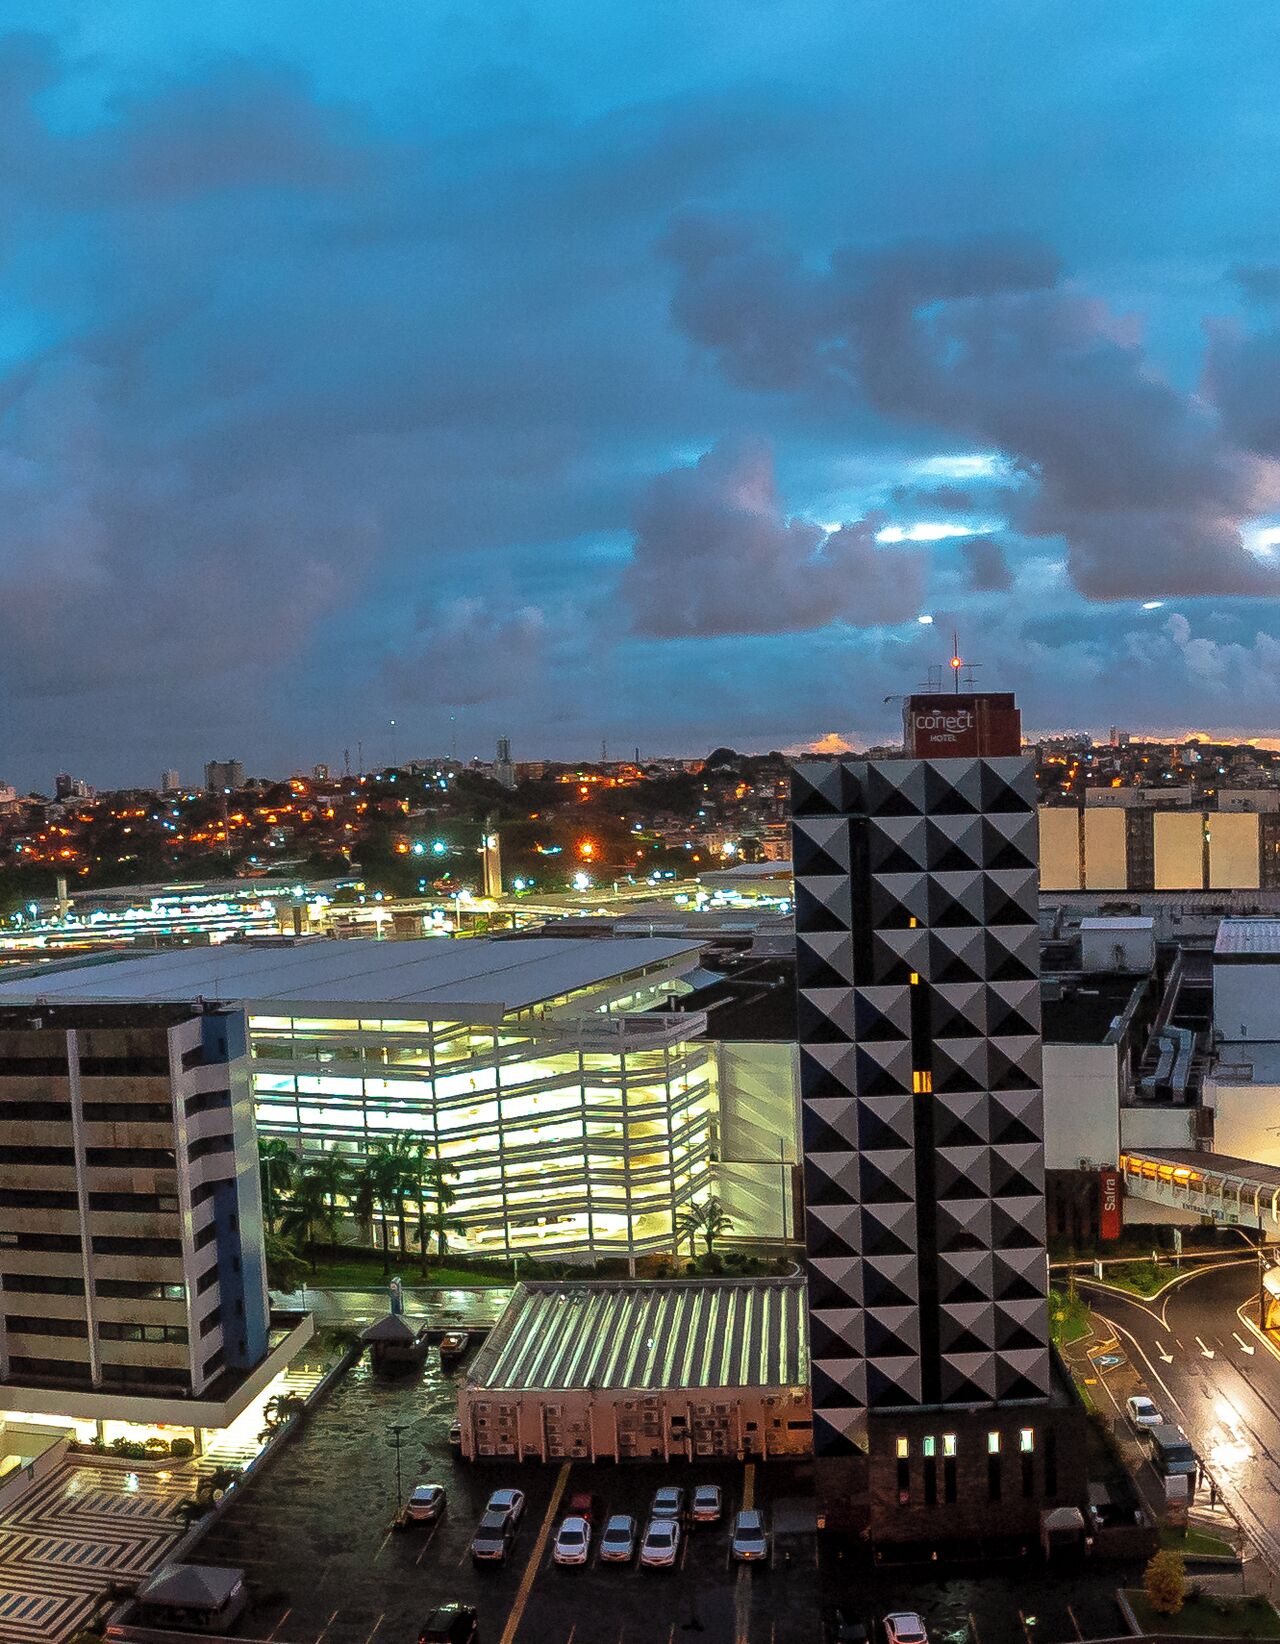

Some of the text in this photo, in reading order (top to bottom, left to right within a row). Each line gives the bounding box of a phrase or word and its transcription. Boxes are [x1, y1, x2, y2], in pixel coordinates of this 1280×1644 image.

[916, 711, 974, 731] conect
[929, 734, 957, 742] HOTEL
[1104, 1178, 1116, 1211] Safra
